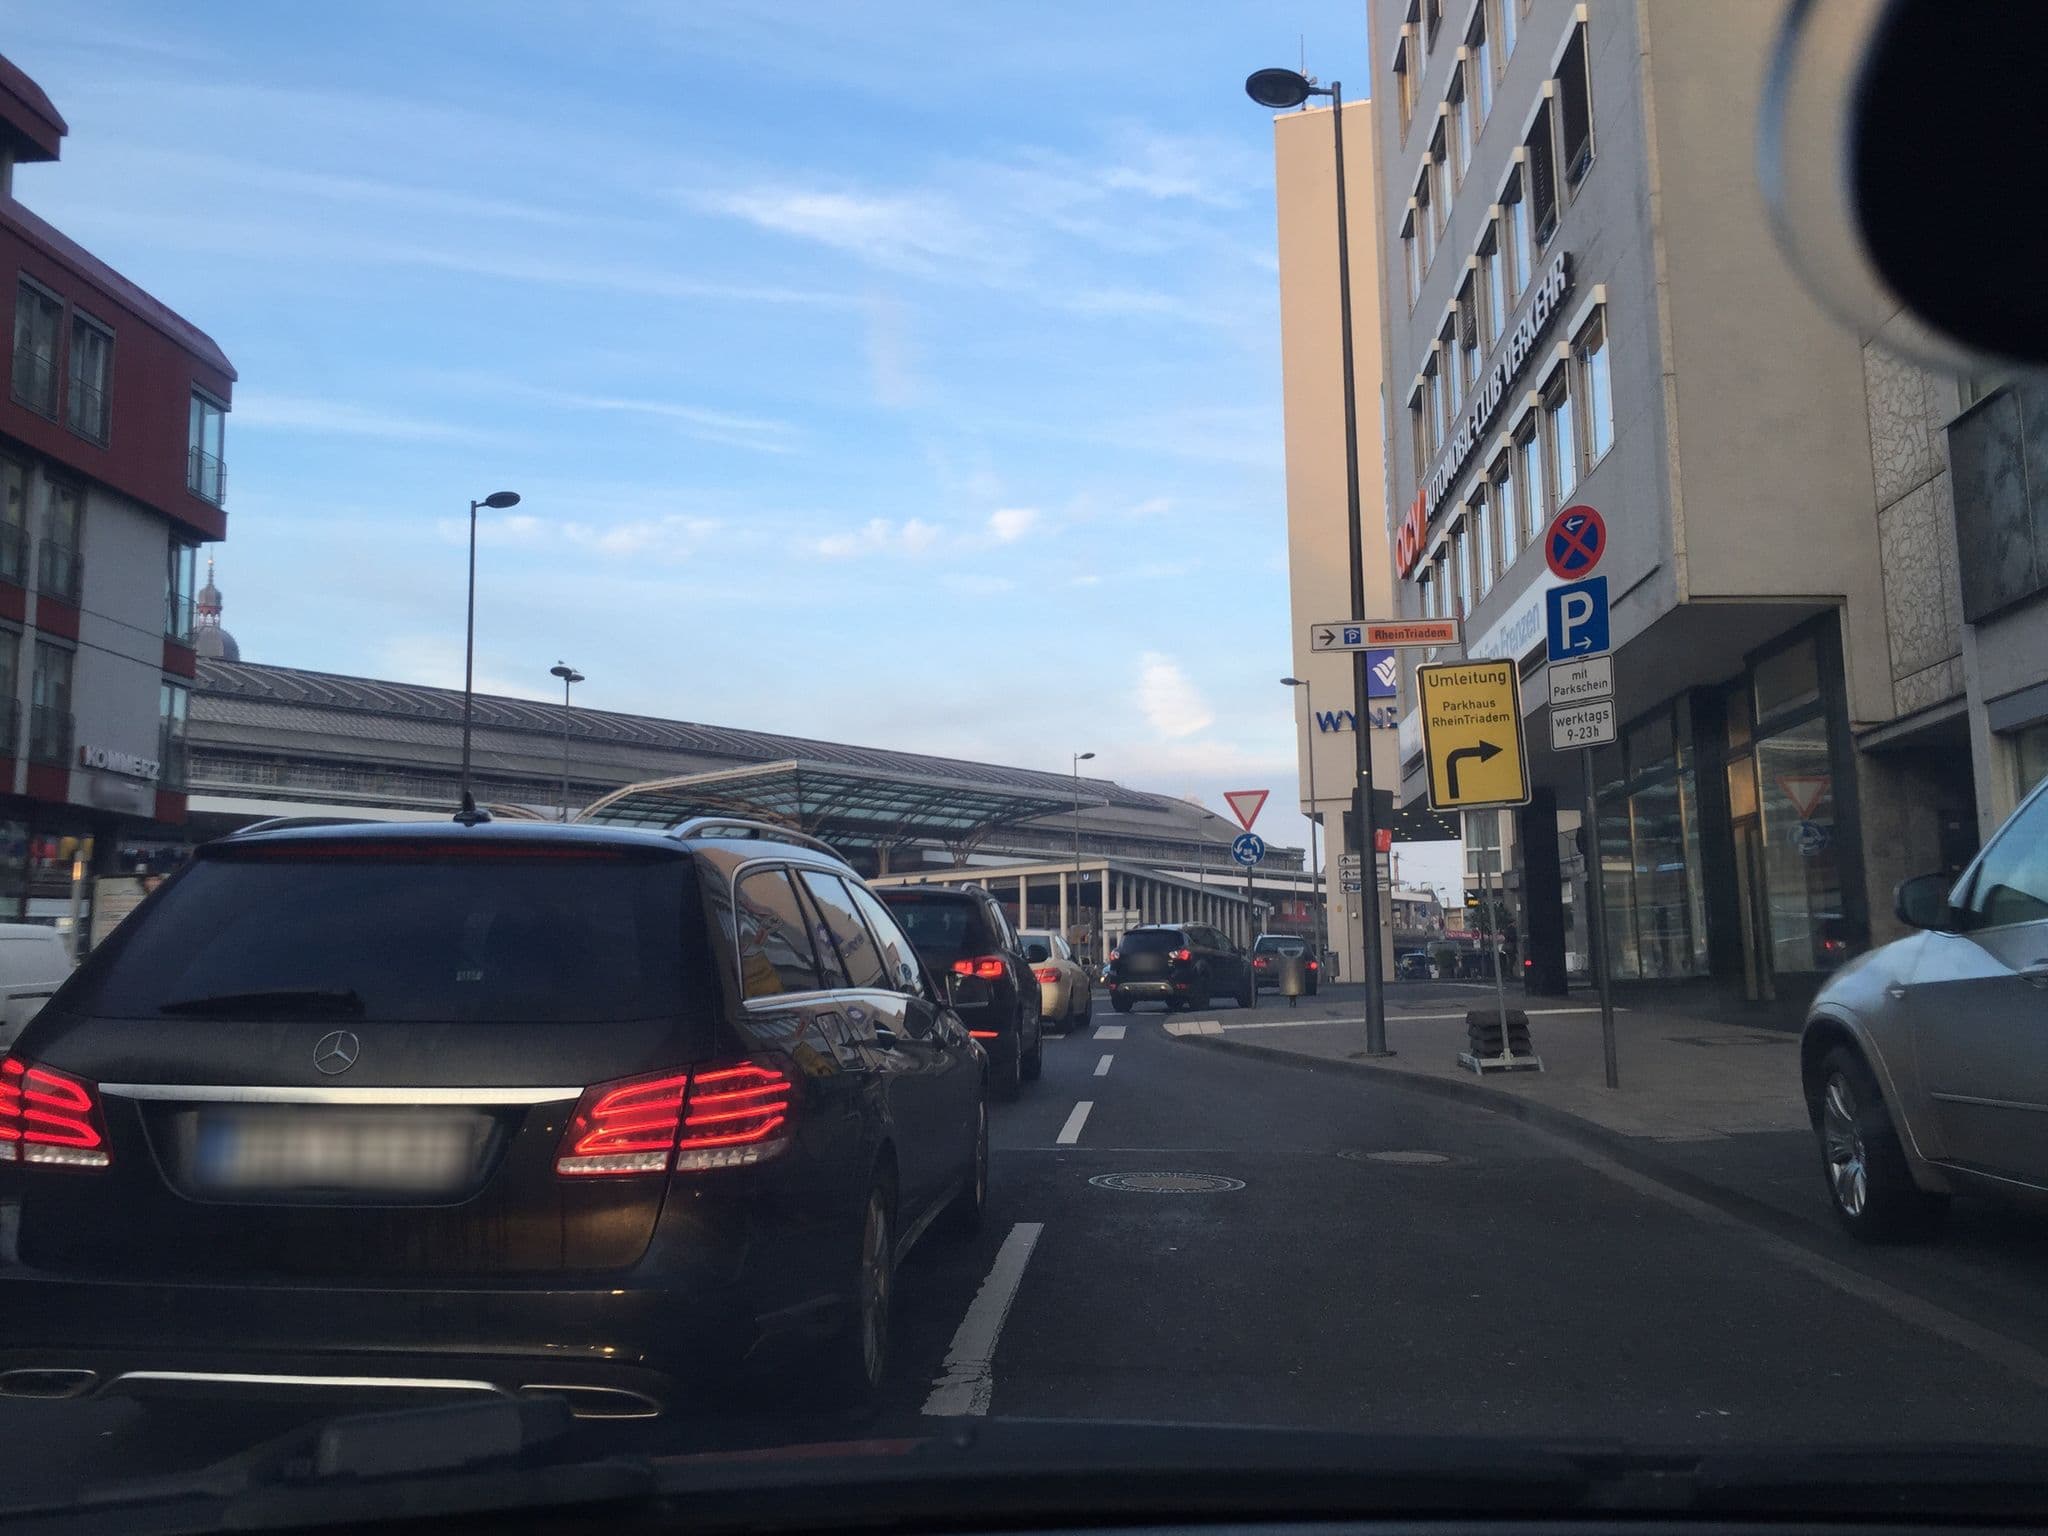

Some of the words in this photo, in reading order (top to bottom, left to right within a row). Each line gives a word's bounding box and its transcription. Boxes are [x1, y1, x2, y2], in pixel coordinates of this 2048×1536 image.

[1424, 364, 1503, 521] AUTOMOBIL-CLUB
[1503, 251, 1567, 385] VERKEHR
[1561, 590, 1594, 650] P
[1375, 628, 1447, 640] RheinTriadem
[1428, 671, 1507, 687] Umleitung
[1571, 669, 1588, 681] mit
[1553, 680, 1609, 697] Parkschein
[1442, 699, 1496, 711] Parkhaus
[1432, 713, 1510, 727] RheinTriadem
[1555, 709, 1610, 727] werktags
[1567, 725, 1600, 741] 9-23h
